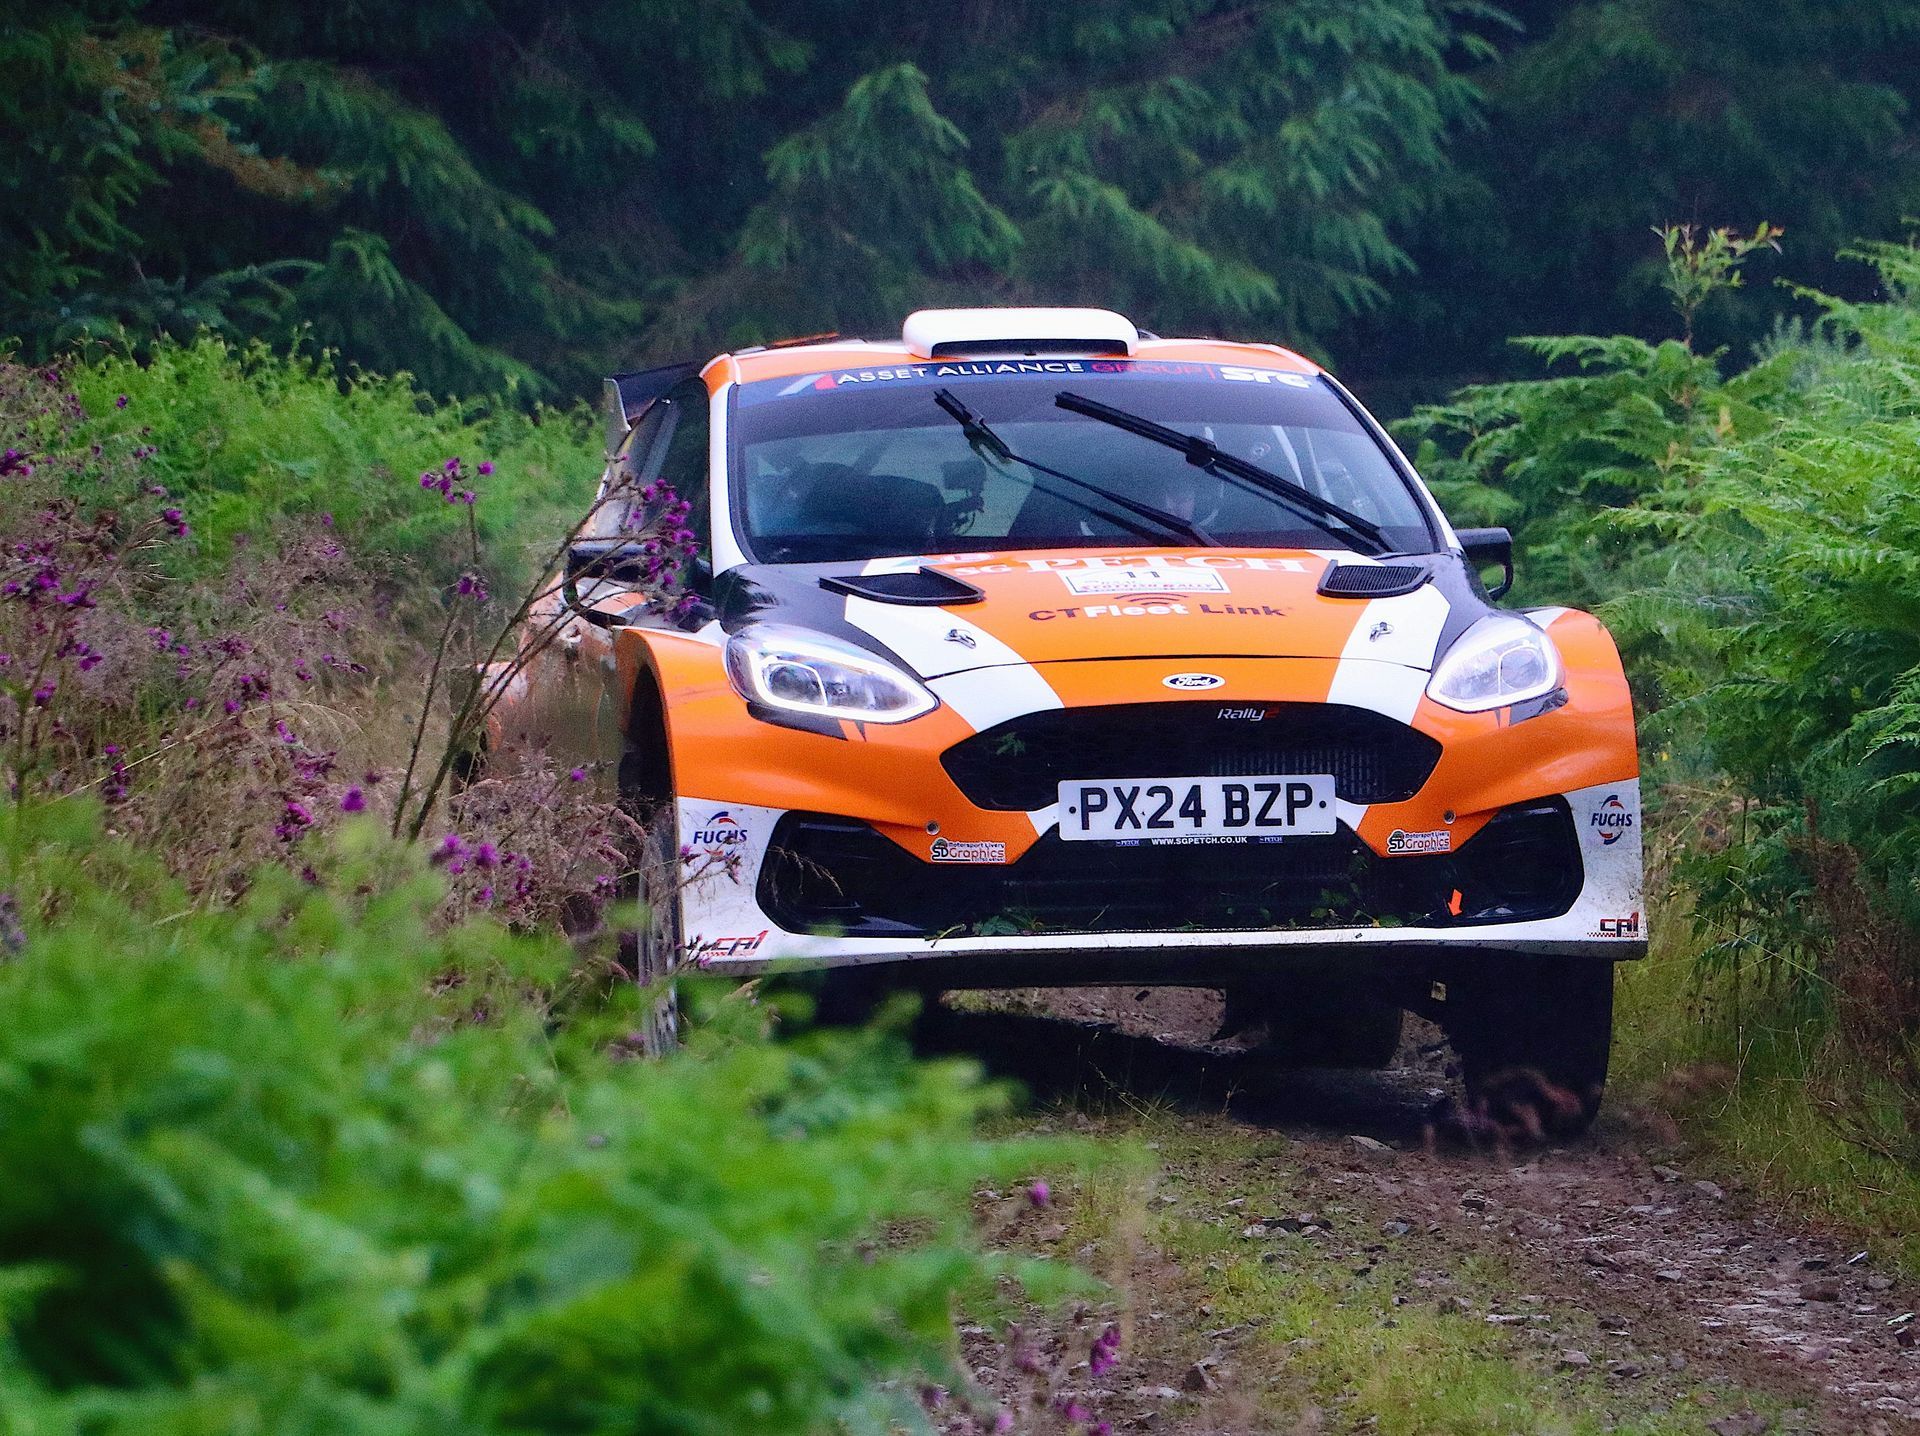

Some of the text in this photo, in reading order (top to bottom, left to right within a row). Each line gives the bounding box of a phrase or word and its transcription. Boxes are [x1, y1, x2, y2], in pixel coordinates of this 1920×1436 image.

[838, 366, 927, 386] ASSET
[937, 362, 1084, 376] ALLIANCE
[955, 555, 1313, 576] SG PETCH
[1120, 570, 1160, 578] 11
[1200, 604, 1289, 617] Link
[1175, 675, 1214, 687] Ford
[1080, 783, 1313, 830] PX24 BZP
[1591, 812, 1633, 827] FUCHS
[693, 829, 747, 844] FUCHS
[1151, 836, 1248, 845] WWW.SGPETCH.CO.UK
